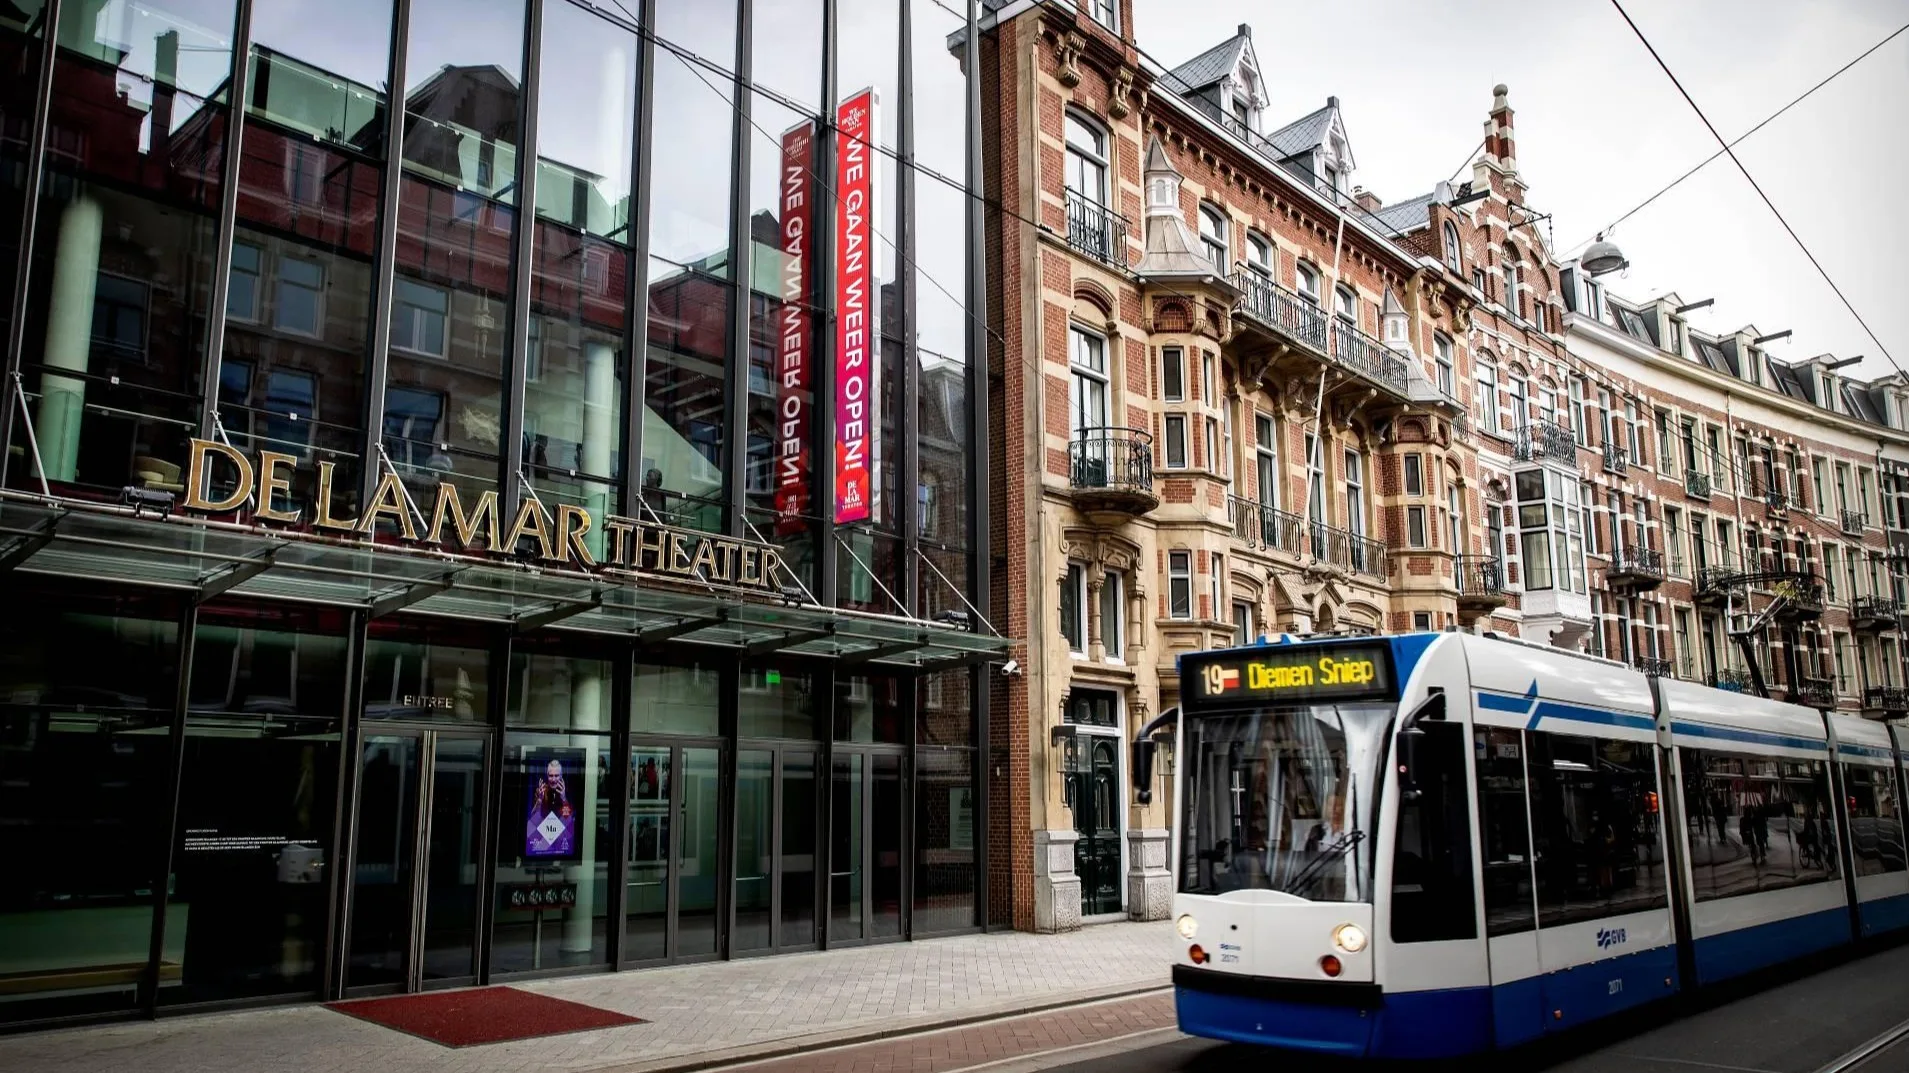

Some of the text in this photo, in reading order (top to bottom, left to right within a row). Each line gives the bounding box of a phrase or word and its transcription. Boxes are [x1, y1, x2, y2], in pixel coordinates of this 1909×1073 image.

[846, 131, 863, 185] WE
[845, 189, 863, 274] GAAN
[845, 278, 863, 371] WEER
[844, 375, 863, 471] OPEN!
[844, 494, 860, 504] MAR
[847, 480, 857, 489] DE
[607, 521, 783, 590] THEATER
[1201, 657, 1375, 696] 19 Diemen Sniep
[404, 694, 453, 709] ENTREE
[1611, 928, 1626, 945] GVB
[1608, 978, 1623, 995] 2071
